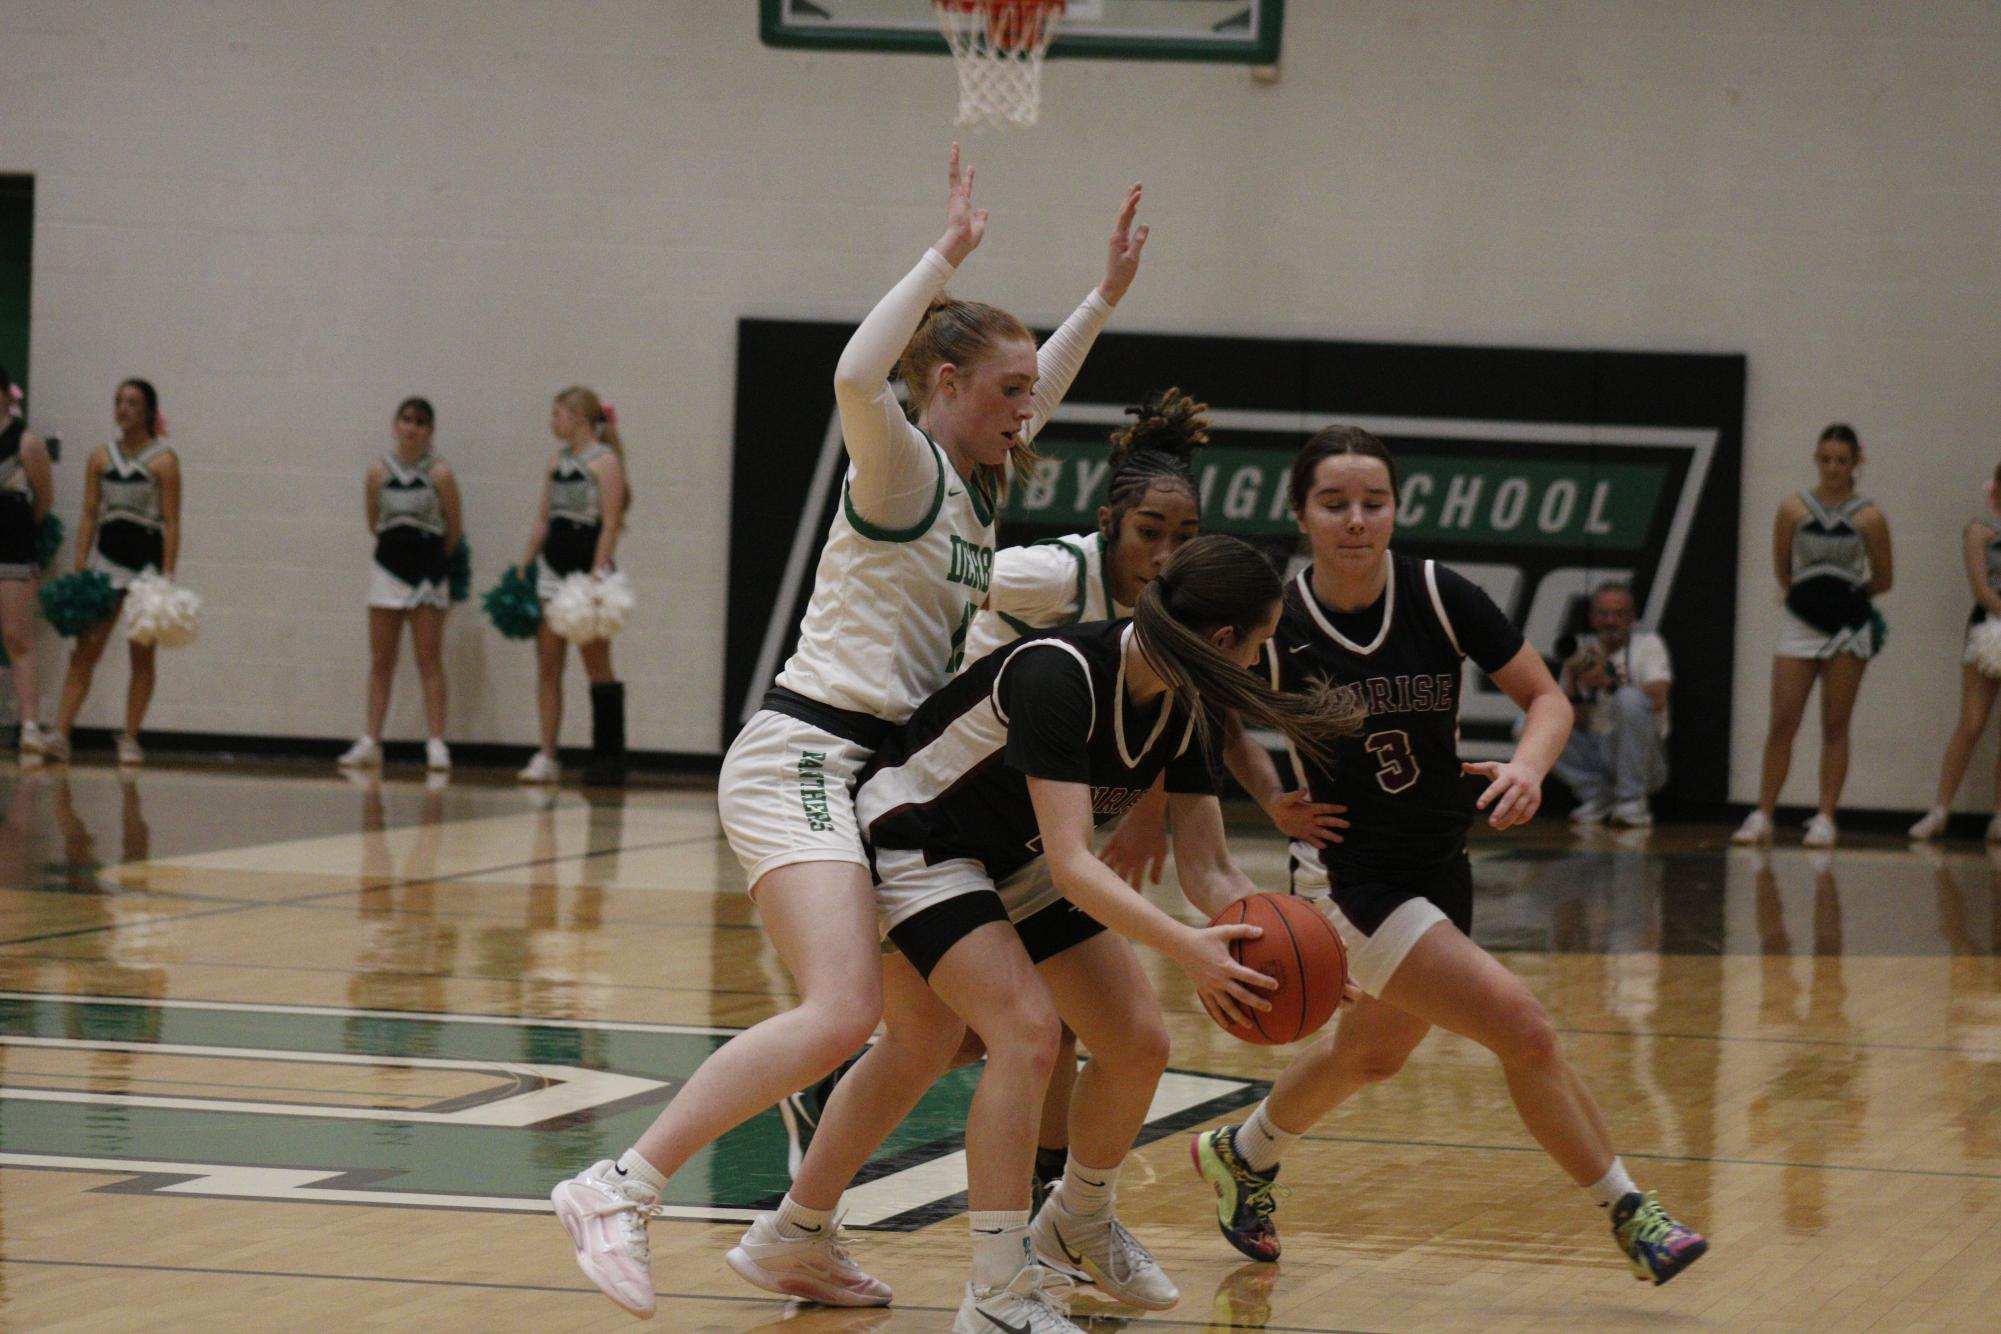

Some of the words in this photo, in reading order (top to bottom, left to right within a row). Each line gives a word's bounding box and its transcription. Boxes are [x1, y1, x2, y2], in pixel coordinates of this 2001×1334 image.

[1395, 472, 1615, 534] CHOOL
[946, 534, 993, 593] DERB
[1364, 729, 1422, 795] 3
